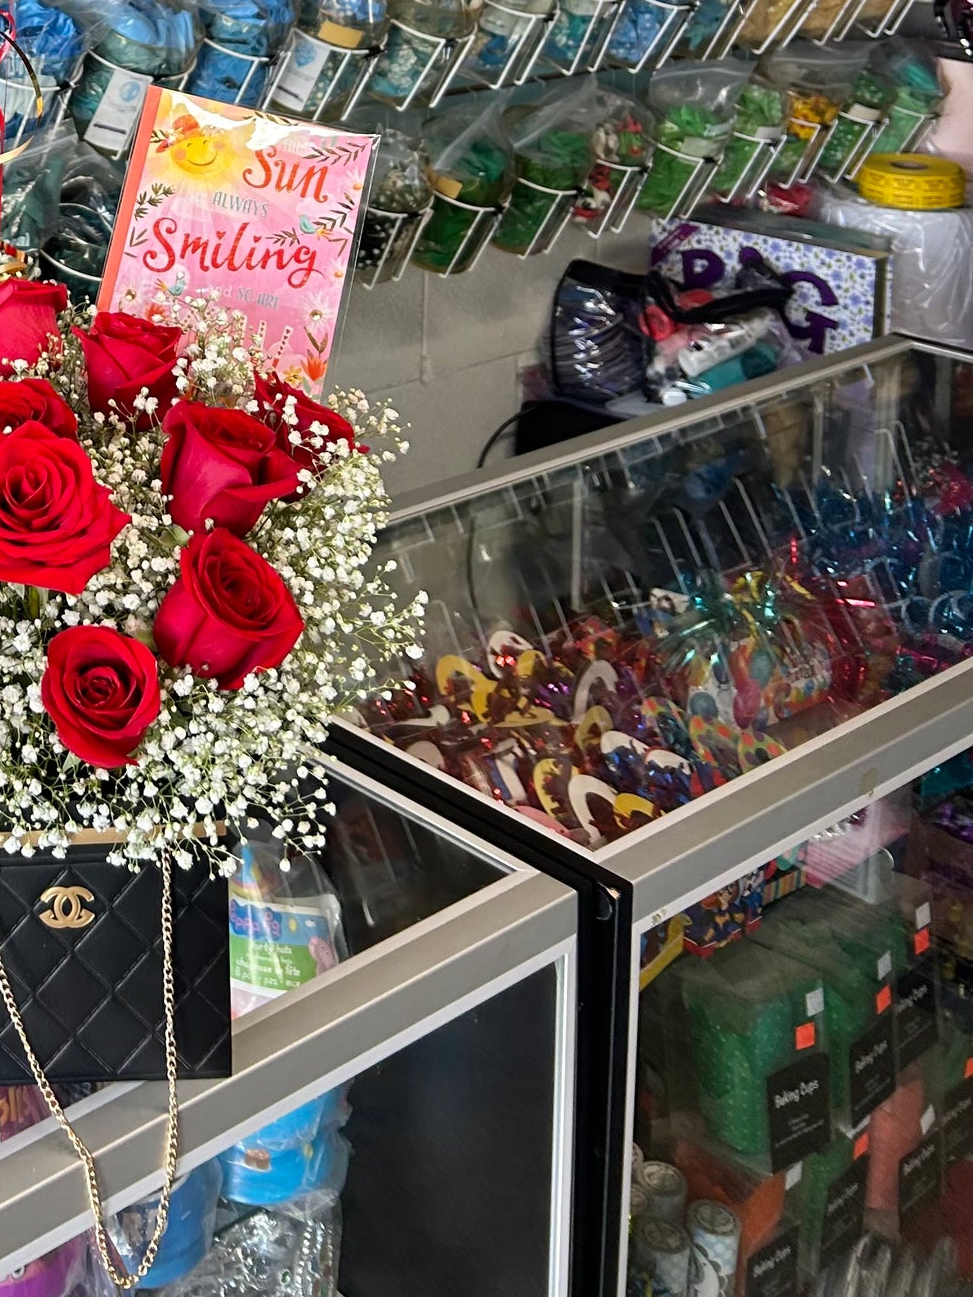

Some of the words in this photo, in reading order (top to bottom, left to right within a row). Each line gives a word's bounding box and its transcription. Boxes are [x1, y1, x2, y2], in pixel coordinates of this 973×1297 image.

[242, 147, 329, 203] Sun
[212, 191, 268, 219] ALWAYS
[142, 217, 325, 289] Smiling
